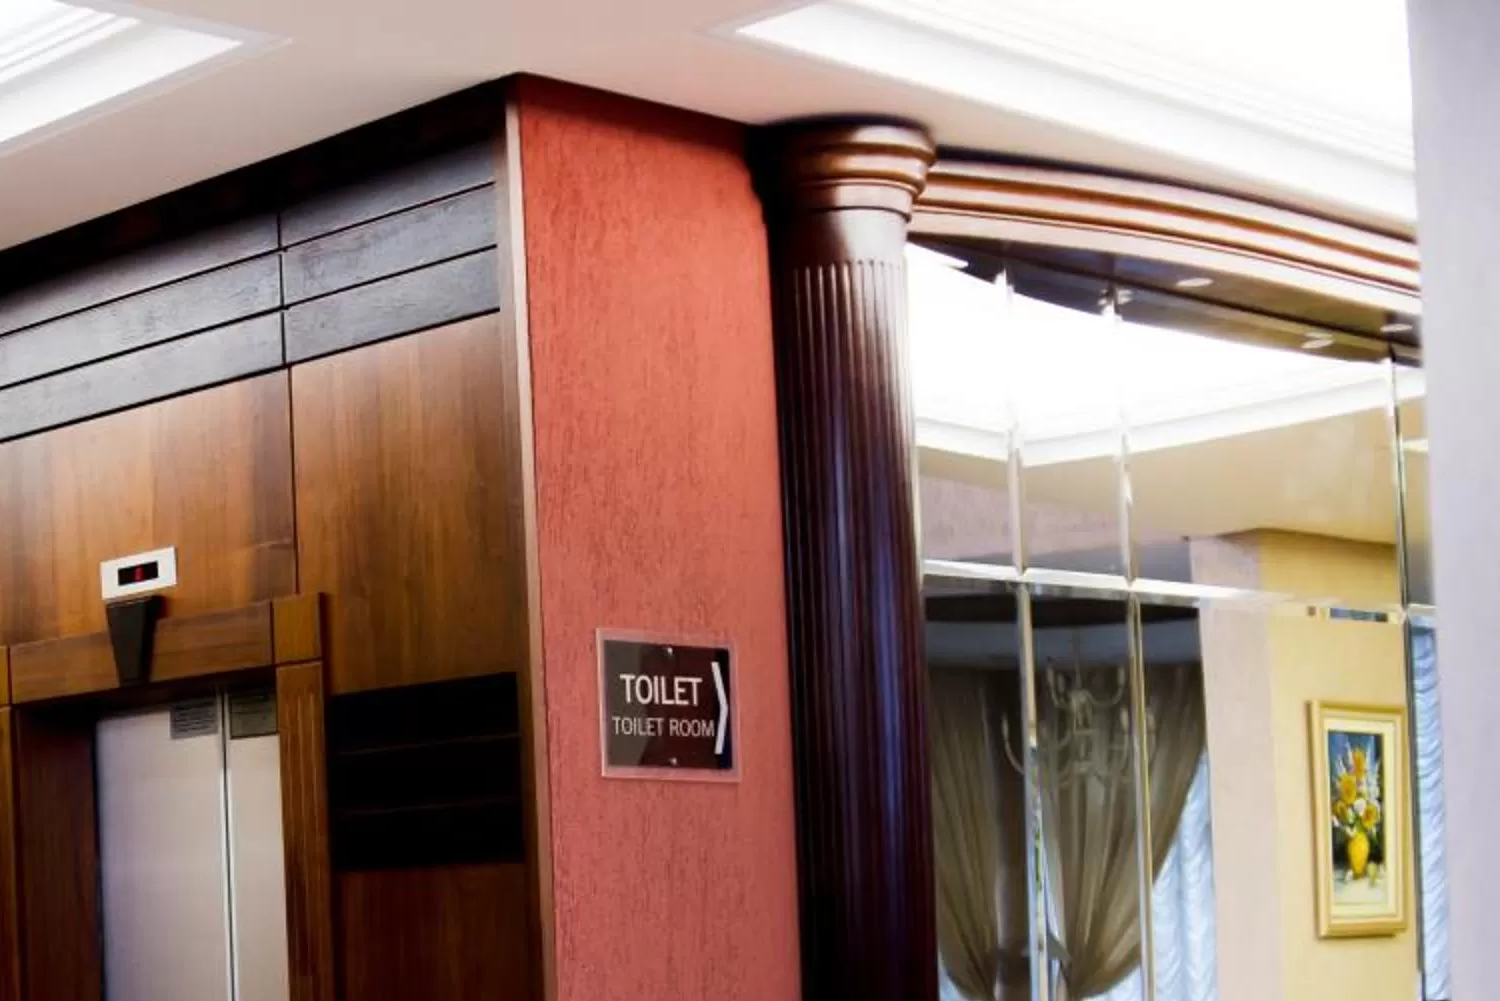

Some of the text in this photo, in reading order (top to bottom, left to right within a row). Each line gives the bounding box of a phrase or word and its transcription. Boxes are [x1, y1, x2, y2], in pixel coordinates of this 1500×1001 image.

[619, 674, 703, 706] TOILET
[612, 716, 715, 737] TOILET ROOM
